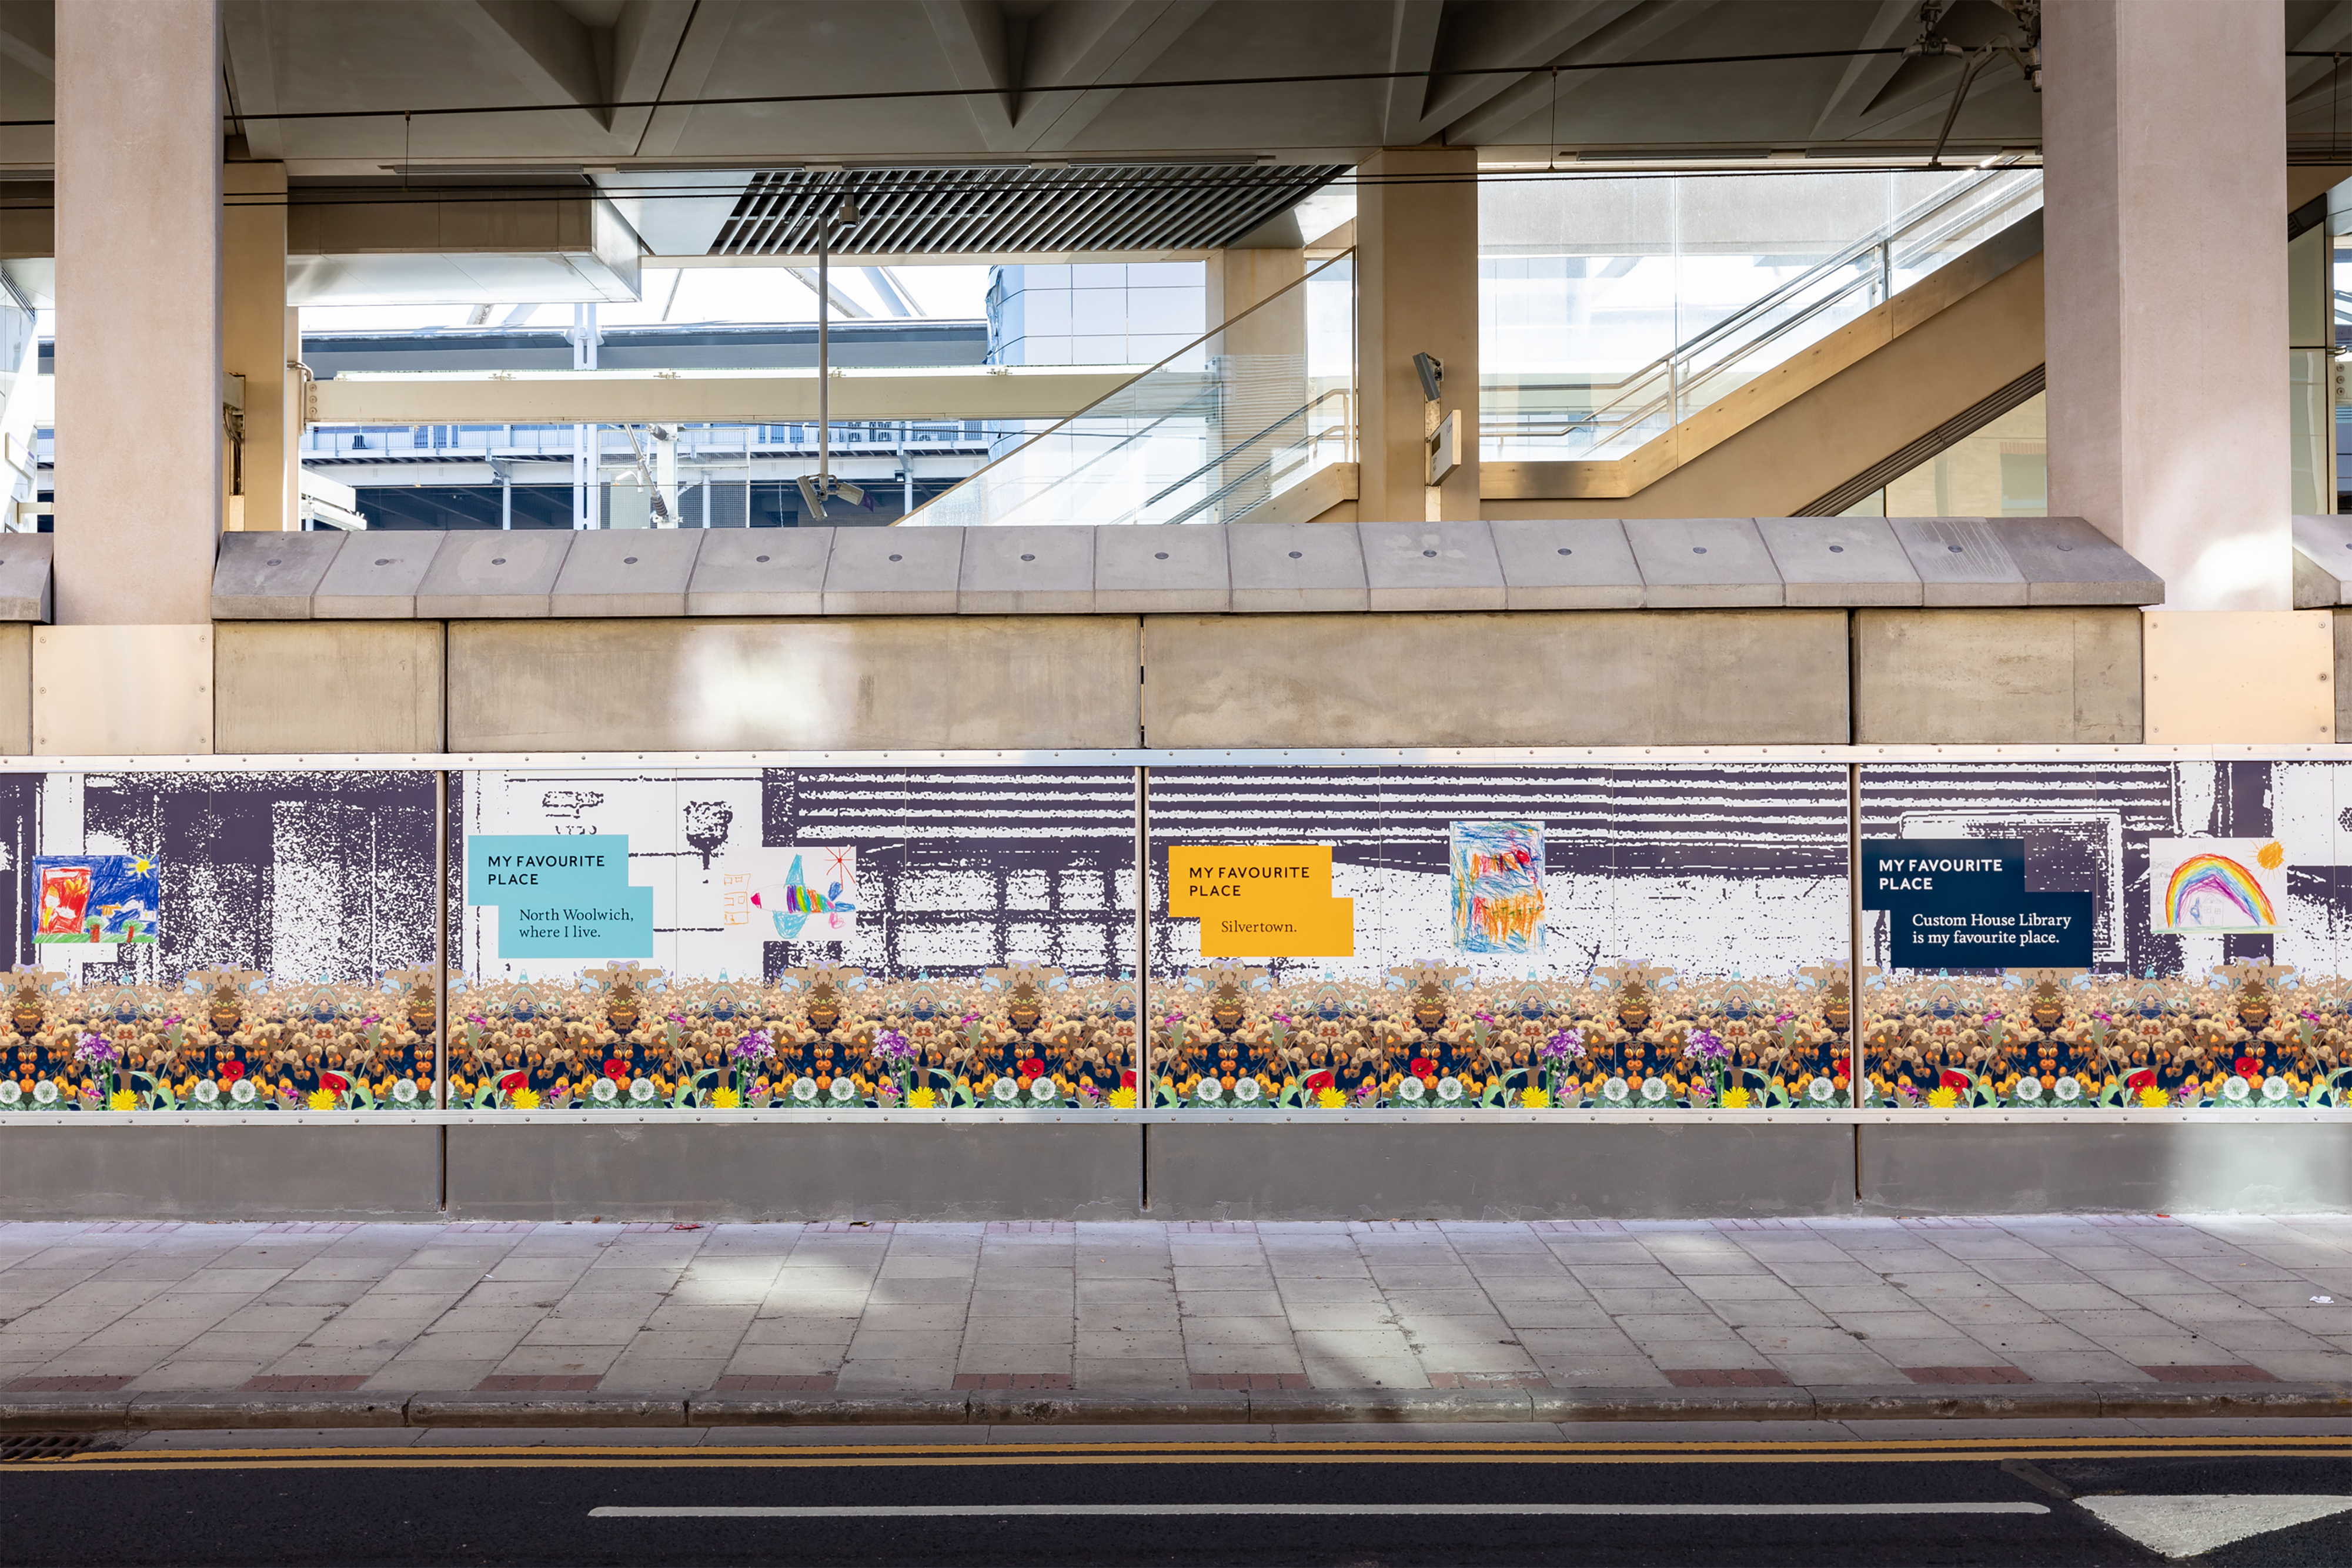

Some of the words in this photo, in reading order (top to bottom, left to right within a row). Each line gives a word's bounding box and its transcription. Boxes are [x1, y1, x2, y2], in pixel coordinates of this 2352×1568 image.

[488, 855, 513, 867] MY
[516, 855, 605, 867] FAVOURITE
[1879, 859, 1905, 872] MY
[1909, 859, 2003, 872] FAVOURITE
[488, 873, 539, 885] PLACE
[1190, 867, 1214, 879] MY
[1218, 867, 1310, 879] FAVOURITE
[1879, 877, 1933, 890] PLACE
[1190, 885, 1241, 897] PLACE
[519, 908, 560, 921] North
[562, 907, 634, 922] Woolwich,
[1912, 913, 1967, 927] Custom
[1970, 913, 2016, 927] House
[2019, 913, 2072, 929] Library
[519, 925, 560, 938] where
[564, 925, 569, 938] I
[573, 925, 601, 938] live.
[1221, 920, 1297, 933] Silvertown.
[1912, 930, 1925, 944] is
[1927, 934, 1951, 947] my
[1953, 930, 2017, 944] favourite
[2019, 930, 2060, 947] place.
